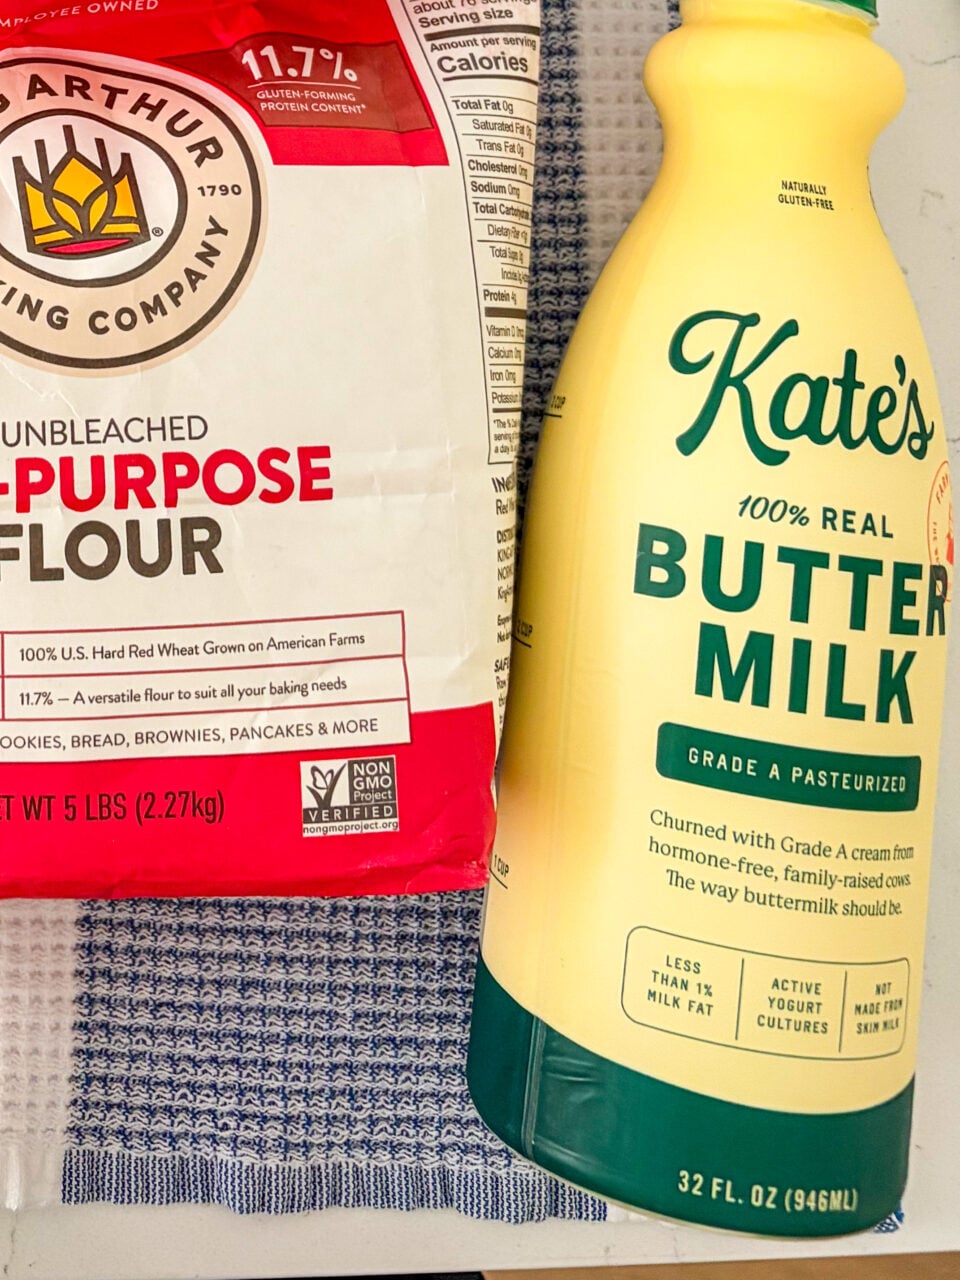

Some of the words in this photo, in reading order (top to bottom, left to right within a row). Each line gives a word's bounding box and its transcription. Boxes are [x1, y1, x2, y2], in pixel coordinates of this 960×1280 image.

[413, 0, 454, 15] about
[242, 45, 358, 81] 11.7%
[437, 52, 528, 73] Calories
[257, 89, 356, 102] GLUTEN-FORMING
[260, 102, 309, 113] PROTEIN
[27, 74, 224, 168] ARTHUR
[197, 183, 241, 197] 1790
[781, 179, 827, 196] NATURALLY
[778, 195, 834, 211] GLUTEN-FREE
[88, 215, 229, 335] COMPANY
[668, 310, 935, 466] Kate's
[2, 415, 208, 447] UNBLEACHED
[738, 494, 810, 527] 100%
[822, 506, 894, 538] REAL
[633, 522, 948, 637] BUTTER
[19, 647, 58, 662] 100%
[61, 647, 89, 660] U.S.
[92, 645, 125, 660] Hard
[129, 645, 154, 659] Red
[158, 642, 200, 657] Wheat
[203, 640, 245, 655] Grown
[249, 642, 264, 653] on
[267, 635, 326, 651] American
[329, 632, 365, 646] Farms
[695, 621, 917, 725] MILK
[353, 760, 390, 776] NON
[688, 747, 758, 776] GRADE
[769, 763, 780, 780] A
[792, 767, 906, 793] PASTEURIZED
[353, 774, 392, 790] GMO
[353, 790, 392, 803] Project
[22, 794, 56, 821] WT
[64, 794, 76, 821] 5
[86, 793, 127, 821] LBS
[135, 790, 225, 825] (2.27kg)
[308, 805, 393, 822] VERIFIED
[303, 820, 399, 834] nongmoproject.org
[771, 977, 822, 996] ACTIVE
[768, 996, 823, 1015] YOGURT
[756, 1014, 829, 1034] CULTURES
[677, 1169, 704, 1197] 32
[711, 1177, 743, 1205] FL.
[751, 1184, 777, 1209] OZ
[784, 1188, 859, 1213] (946ML)
